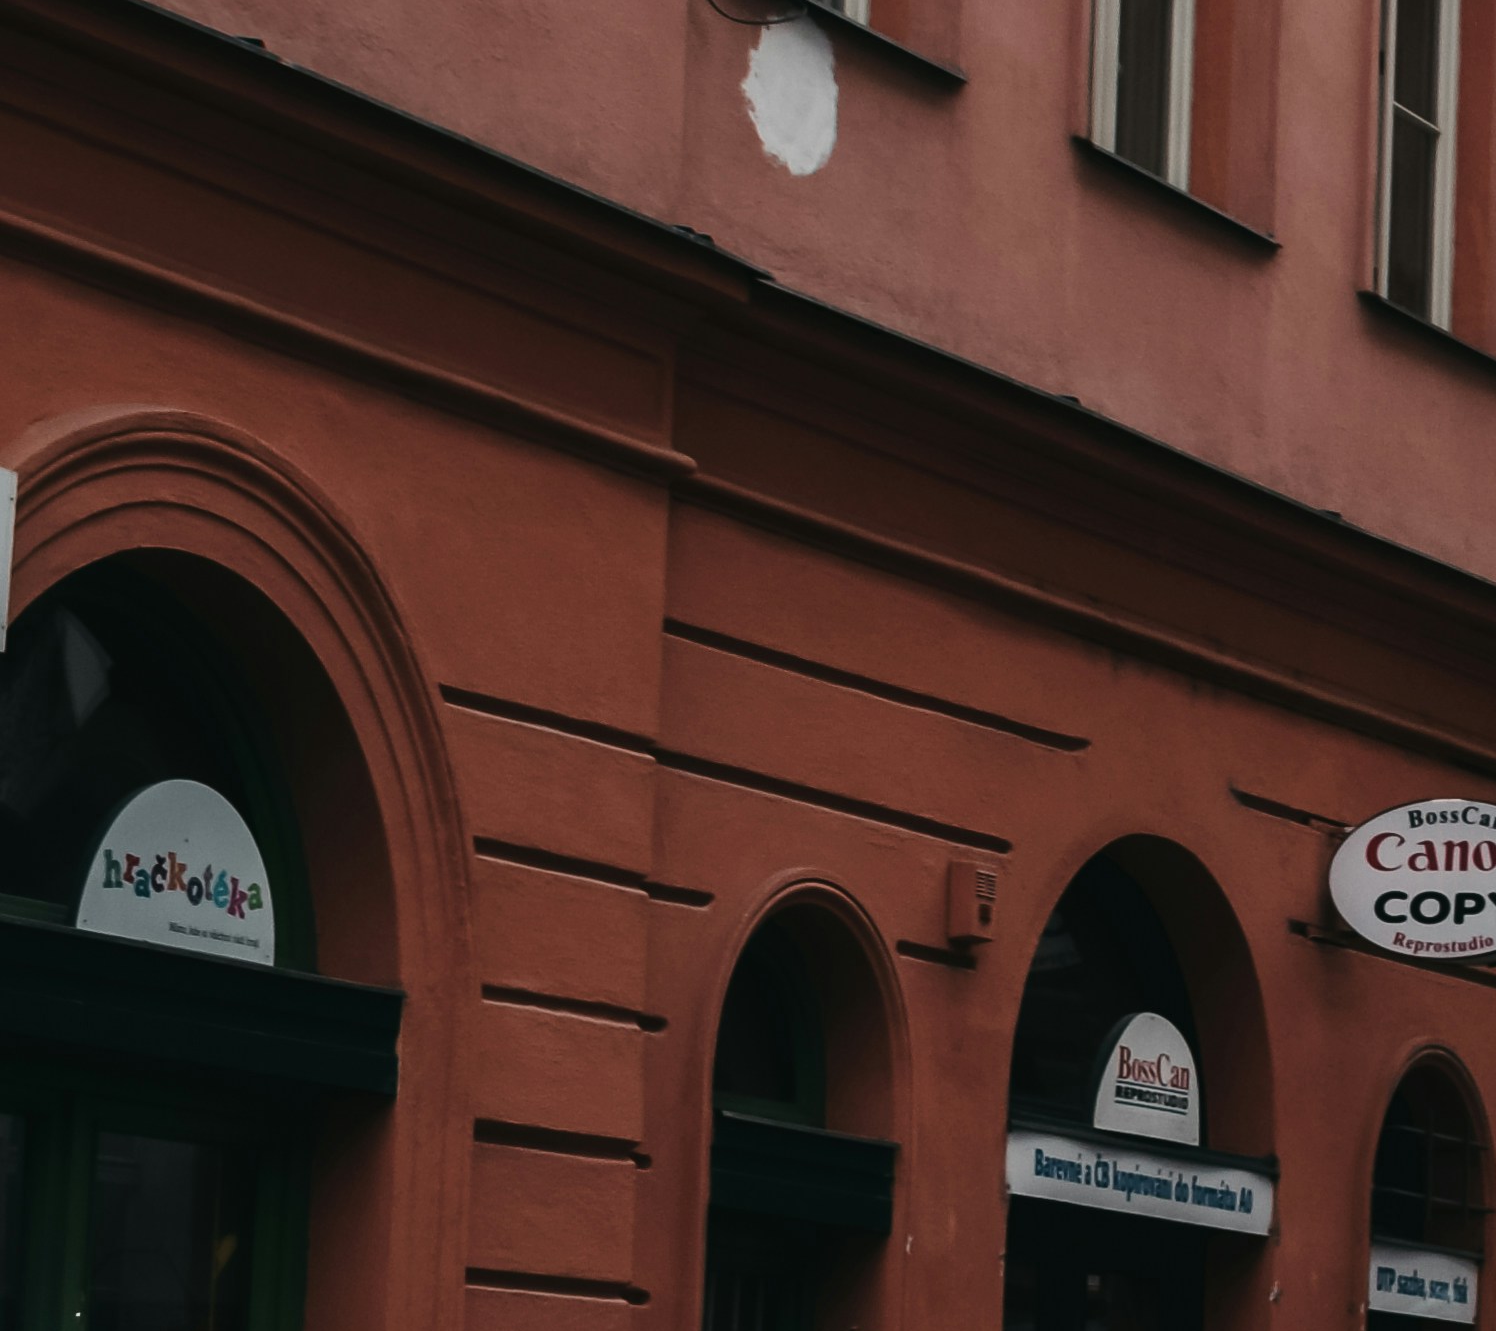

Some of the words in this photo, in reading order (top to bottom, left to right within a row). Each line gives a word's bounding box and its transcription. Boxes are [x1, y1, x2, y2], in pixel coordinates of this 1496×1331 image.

[103, 849, 263, 919] hračkotéka
[1392, 932, 1494, 954] Reprostudio
[1117, 1045, 1190, 1090] BossCan
